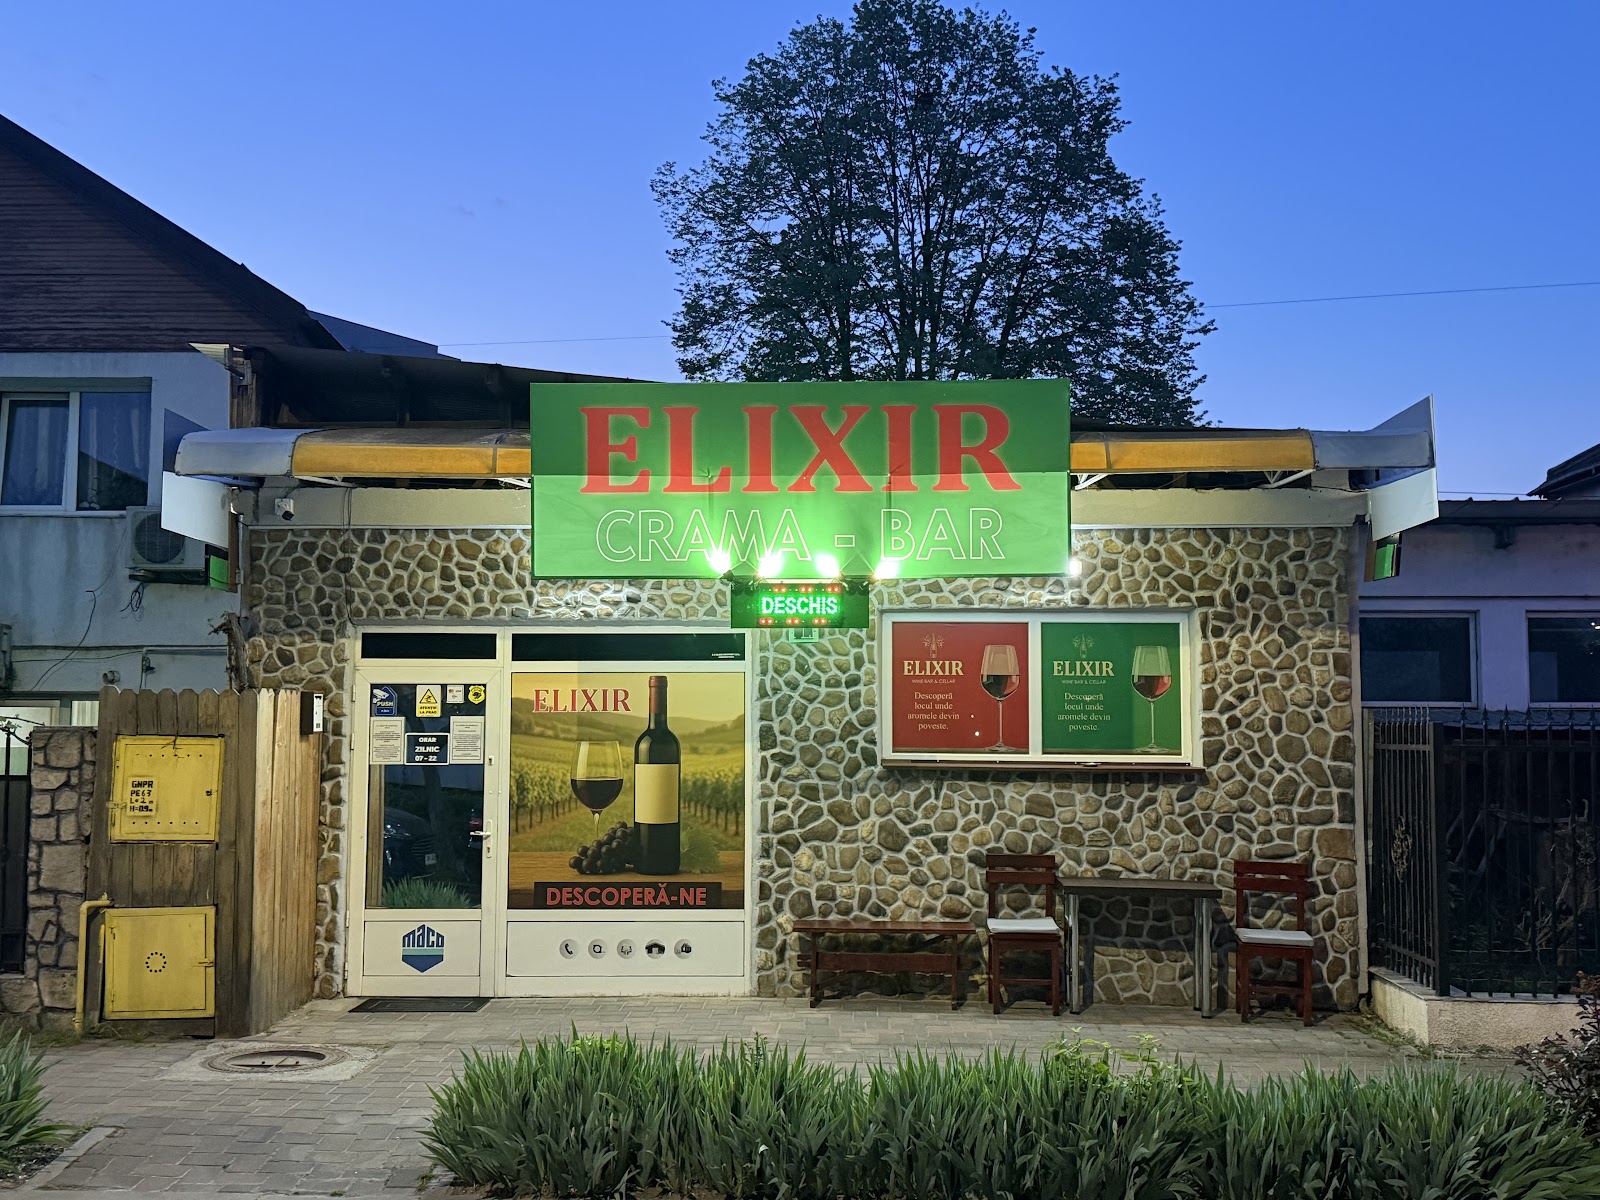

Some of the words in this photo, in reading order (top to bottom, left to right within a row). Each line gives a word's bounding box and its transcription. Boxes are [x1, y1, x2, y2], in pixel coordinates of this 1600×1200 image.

[579, 404, 1022, 494] ELIXIR
[595, 508, 811, 562] CRAMA
[879, 507, 1005, 561] BAR
[761, 596, 838, 614] DESCHIS
[903, 660, 964, 676] ELIXIR
[1053, 661, 1115, 677] ELIXIR
[533, 688, 632, 712] ELIXIR
[914, 691, 953, 701] Descoperă
[914, 702, 933, 710] locul
[935, 702, 953, 710] unde
[1064, 703, 1083, 711] locul
[1085, 703, 1104, 711] unde
[907, 712, 937, 720] aromele
[939, 712, 960, 720] devin
[1057, 713, 1088, 721] aromele
[1090, 713, 1111, 721] devin
[918, 723, 949, 731] poveste.
[1068, 724, 1100, 732] poveste.
[546, 883, 707, 905] DESCOPERĂ-NE
[402, 924, 444, 948] maco
